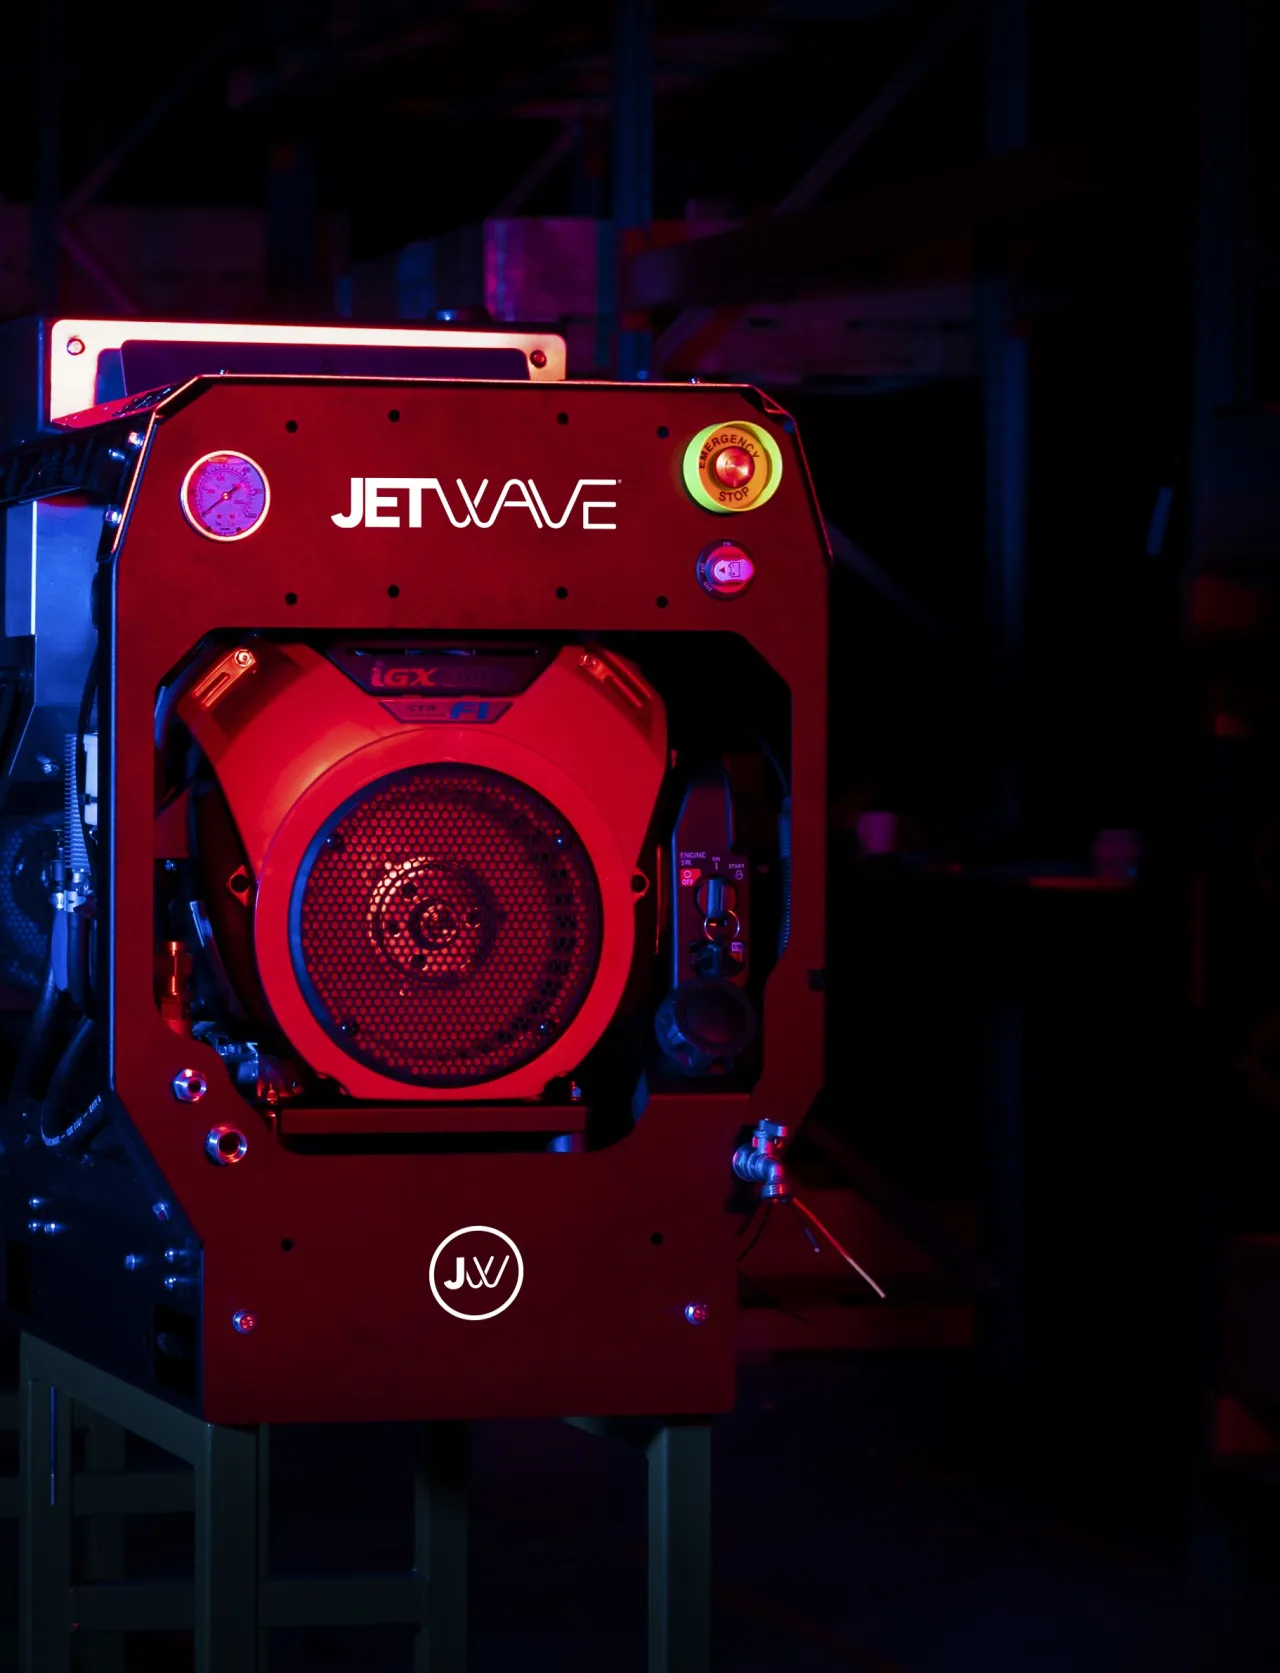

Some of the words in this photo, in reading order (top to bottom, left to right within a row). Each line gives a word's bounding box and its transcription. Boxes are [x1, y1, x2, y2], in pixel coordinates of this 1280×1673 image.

[699, 434, 760, 469] EMERGENCY
[330, 477, 617, 529] JETWAVE
[719, 486, 749, 502] STOP
[370, 660, 437, 687] iGX
[449, 702, 490, 720] FI
[443, 1254, 510, 1290] JW
